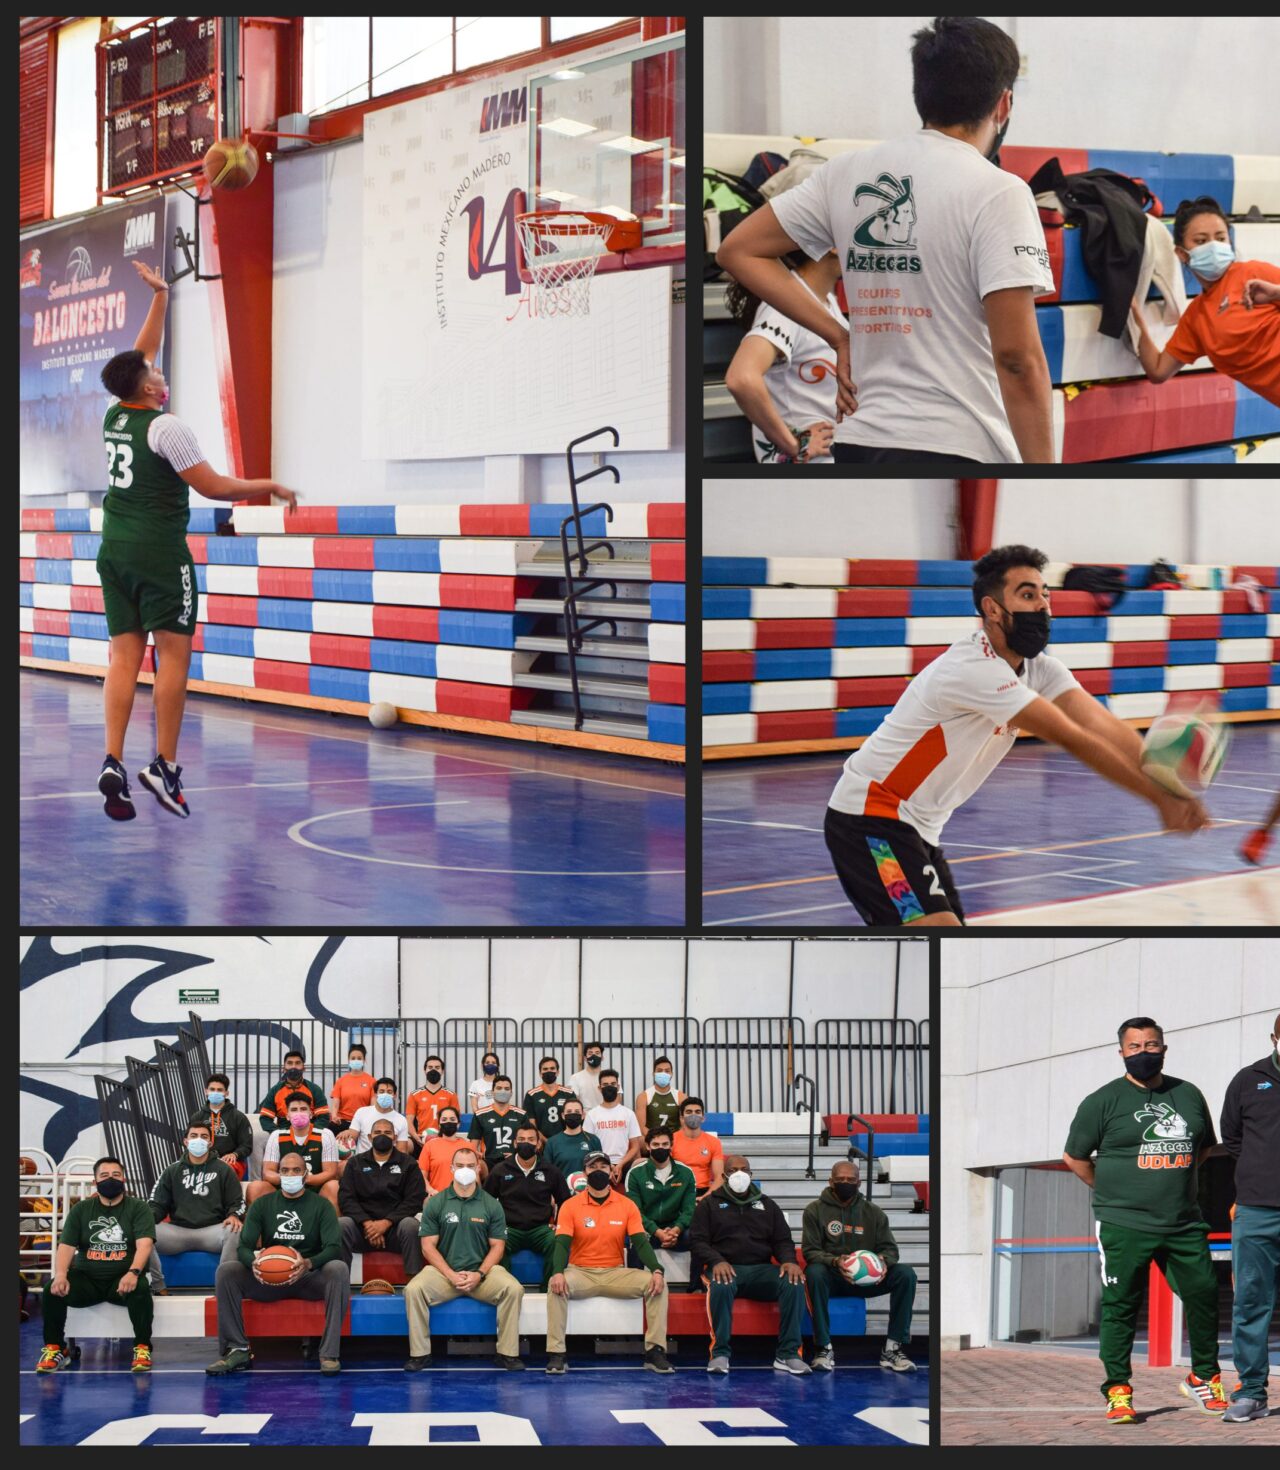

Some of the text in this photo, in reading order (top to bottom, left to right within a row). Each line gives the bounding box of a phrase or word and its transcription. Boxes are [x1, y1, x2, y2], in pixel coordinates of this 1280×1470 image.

[152, 39, 172, 55] TEMPO
[472, 152, 511, 182] MADERO
[439, 176, 471, 248] MEXICANO
[846, 247, 922, 274] Aztecas
[435, 251, 449, 330] INSTITUTO
[857, 288, 901, 299] EQUIPS
[32, 290, 127, 347] BALONCESTO
[850, 306, 933, 319] PRESENTTIVOS
[105, 442, 134, 489] 23
[177, 564, 190, 626] Aztecas
[923, 864, 946, 897] 2
[430, 1104, 438, 1120] 1
[547, 1106, 559, 1123] 8
[658, 1114, 669, 1127] 7
[493, 1126, 513, 1145] 12
[1139, 1142, 1192, 1154] Aztecas
[1137, 1154, 1193, 1169] UDLAP
[273, 1231, 305, 1241] Aztecas
[86, 1250, 128, 1261] UDLAP
